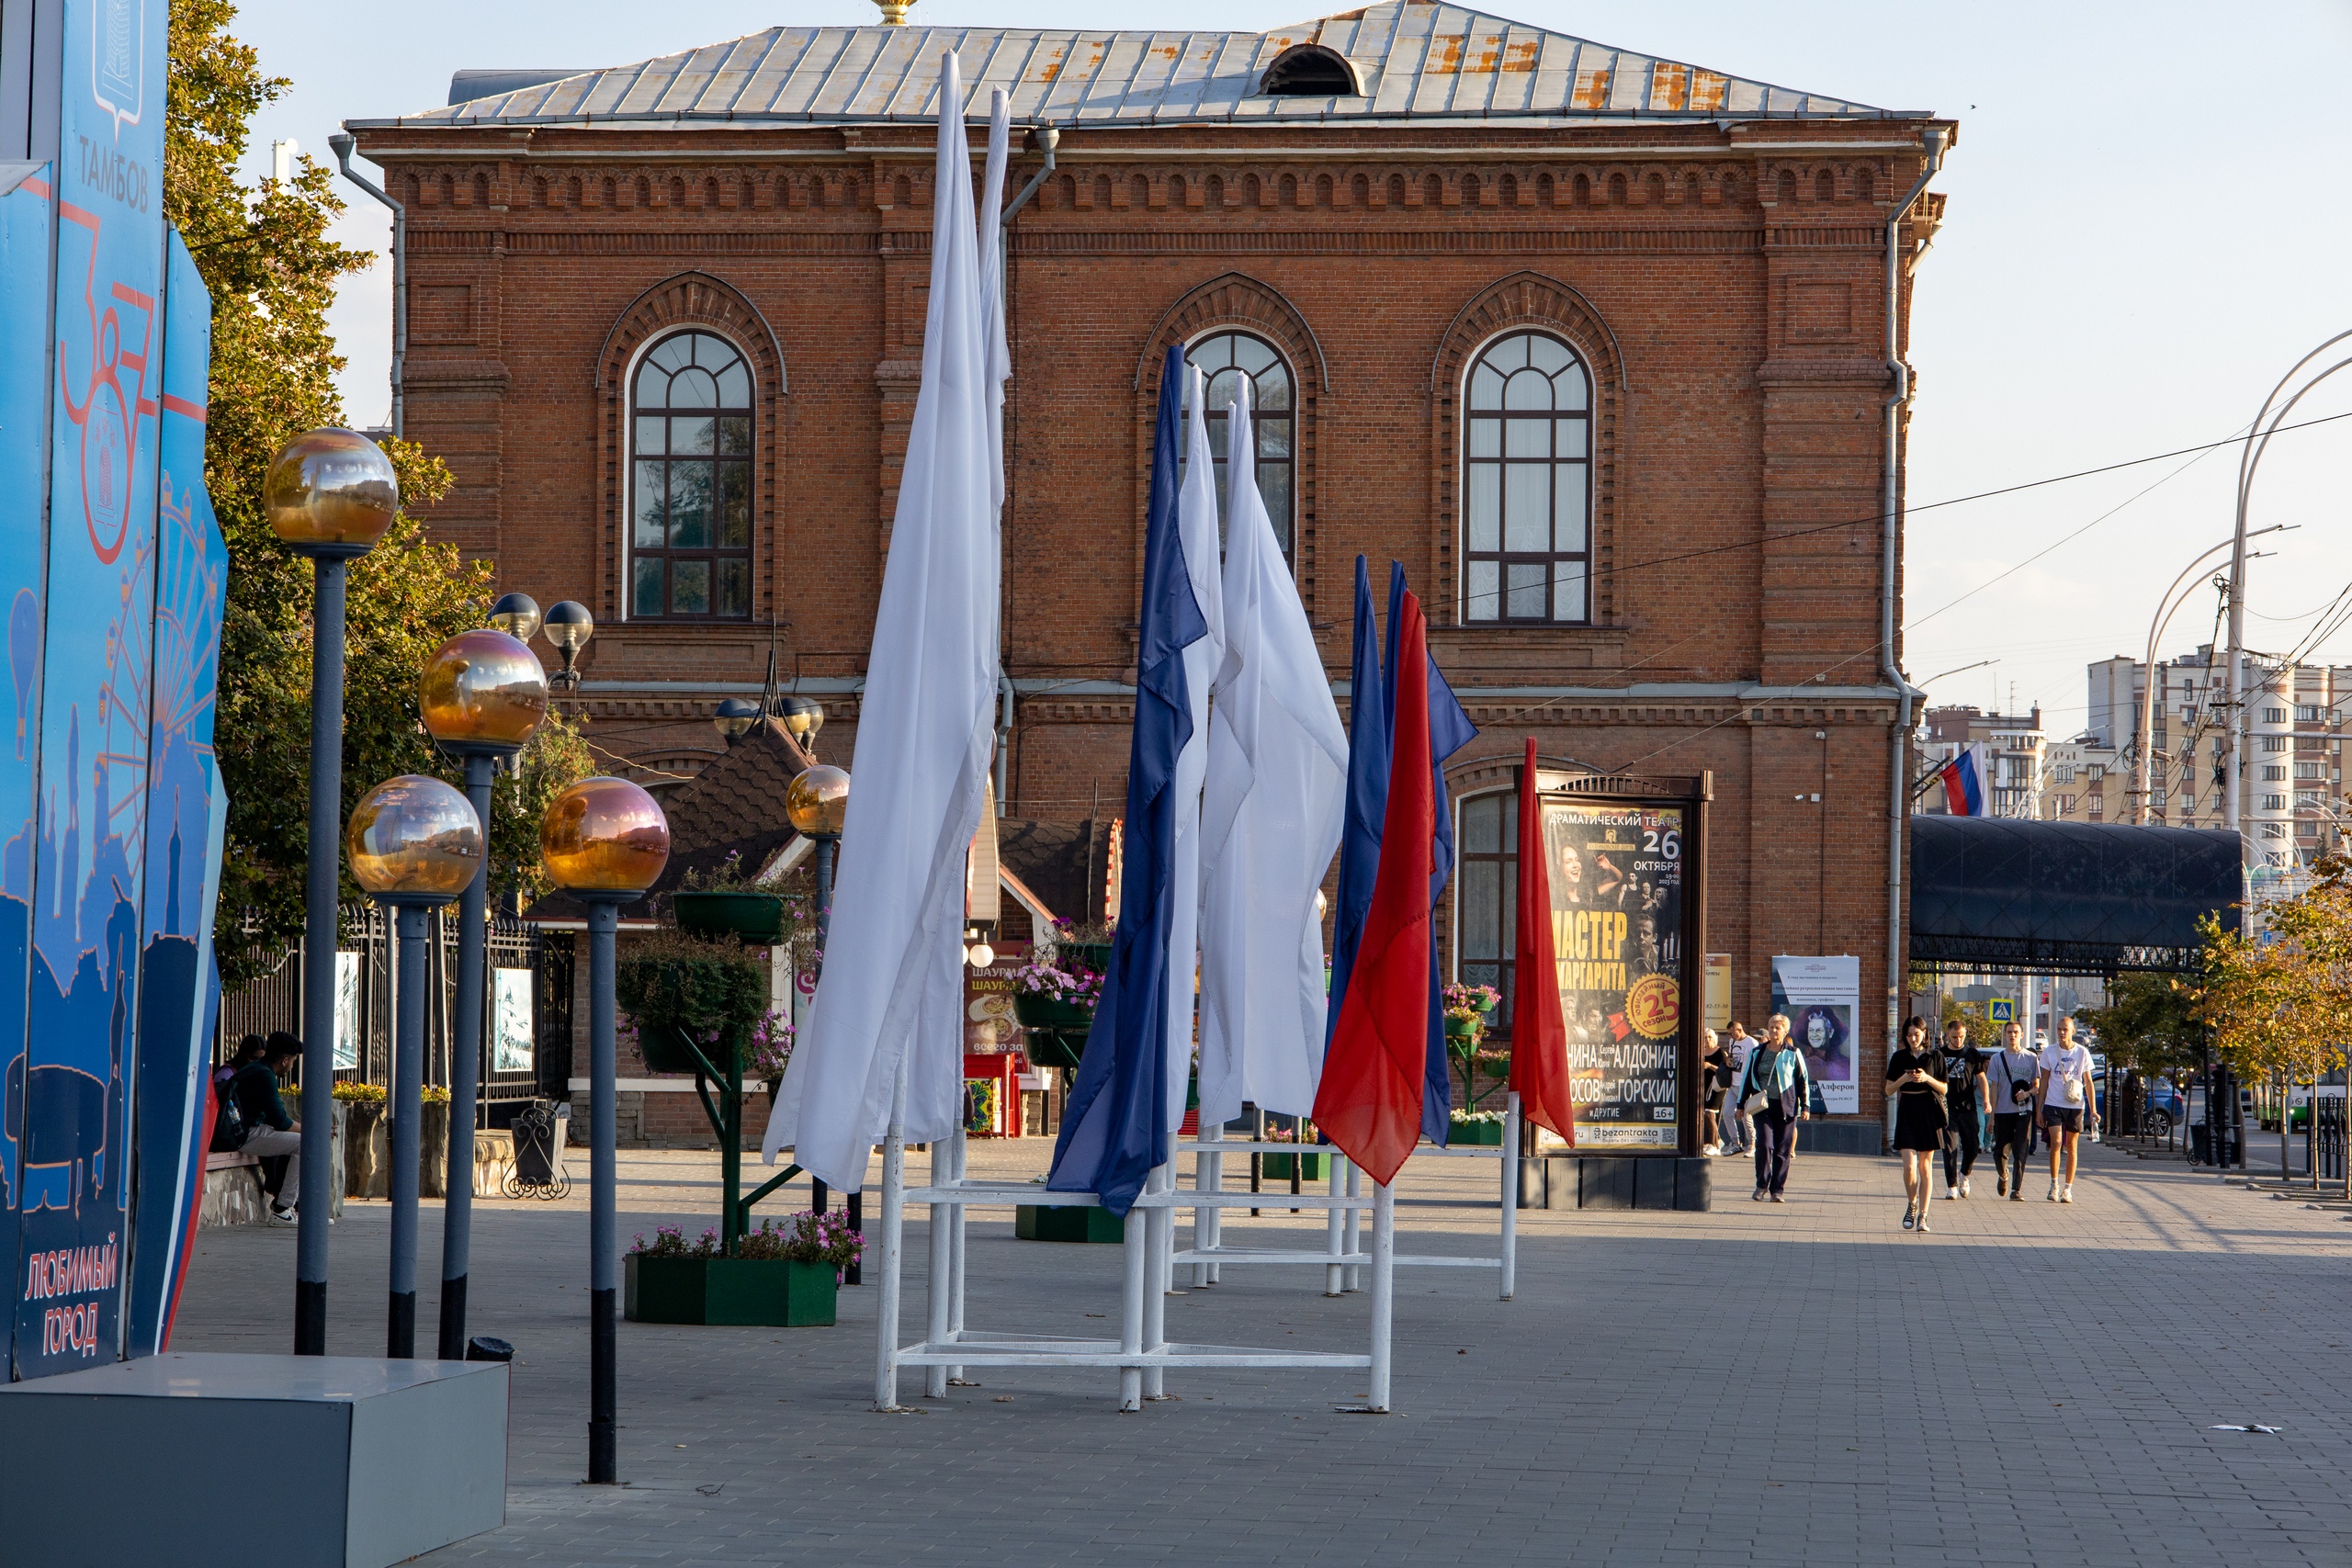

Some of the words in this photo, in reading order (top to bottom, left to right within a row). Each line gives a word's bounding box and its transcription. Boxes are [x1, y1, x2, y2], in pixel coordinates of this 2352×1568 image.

[79, 134, 147, 214] ТАМБОВ
[1549, 813, 1641, 826] ДРАМАТИЧЕСКИЙ
[1645, 817, 1679, 827] ТЕАТР
[1643, 830, 1679, 860] 26
[1634, 861, 1679, 871] ОКТЯБРЯ
[1644, 988, 1679, 1021] 25
[974, 1043, 1006, 1052] всего
[1010, 1043, 1023, 1052] за
[1613, 1043, 1676, 1076] АЛДОНИН
[1618, 1071, 1675, 1103] ГОРСКИЙ
[1820, 1083, 1855, 1092] Алферов
[1594, 1108, 1620, 1119] ДРУГИЕ
[1656, 1109, 1673, 1118] 16+
[1601, 1128, 1658, 1137] bezantrakta
[25, 1231, 117, 1302] ЛЮБИМЫЙ
[43, 1302, 98, 1358] ГОРОД
